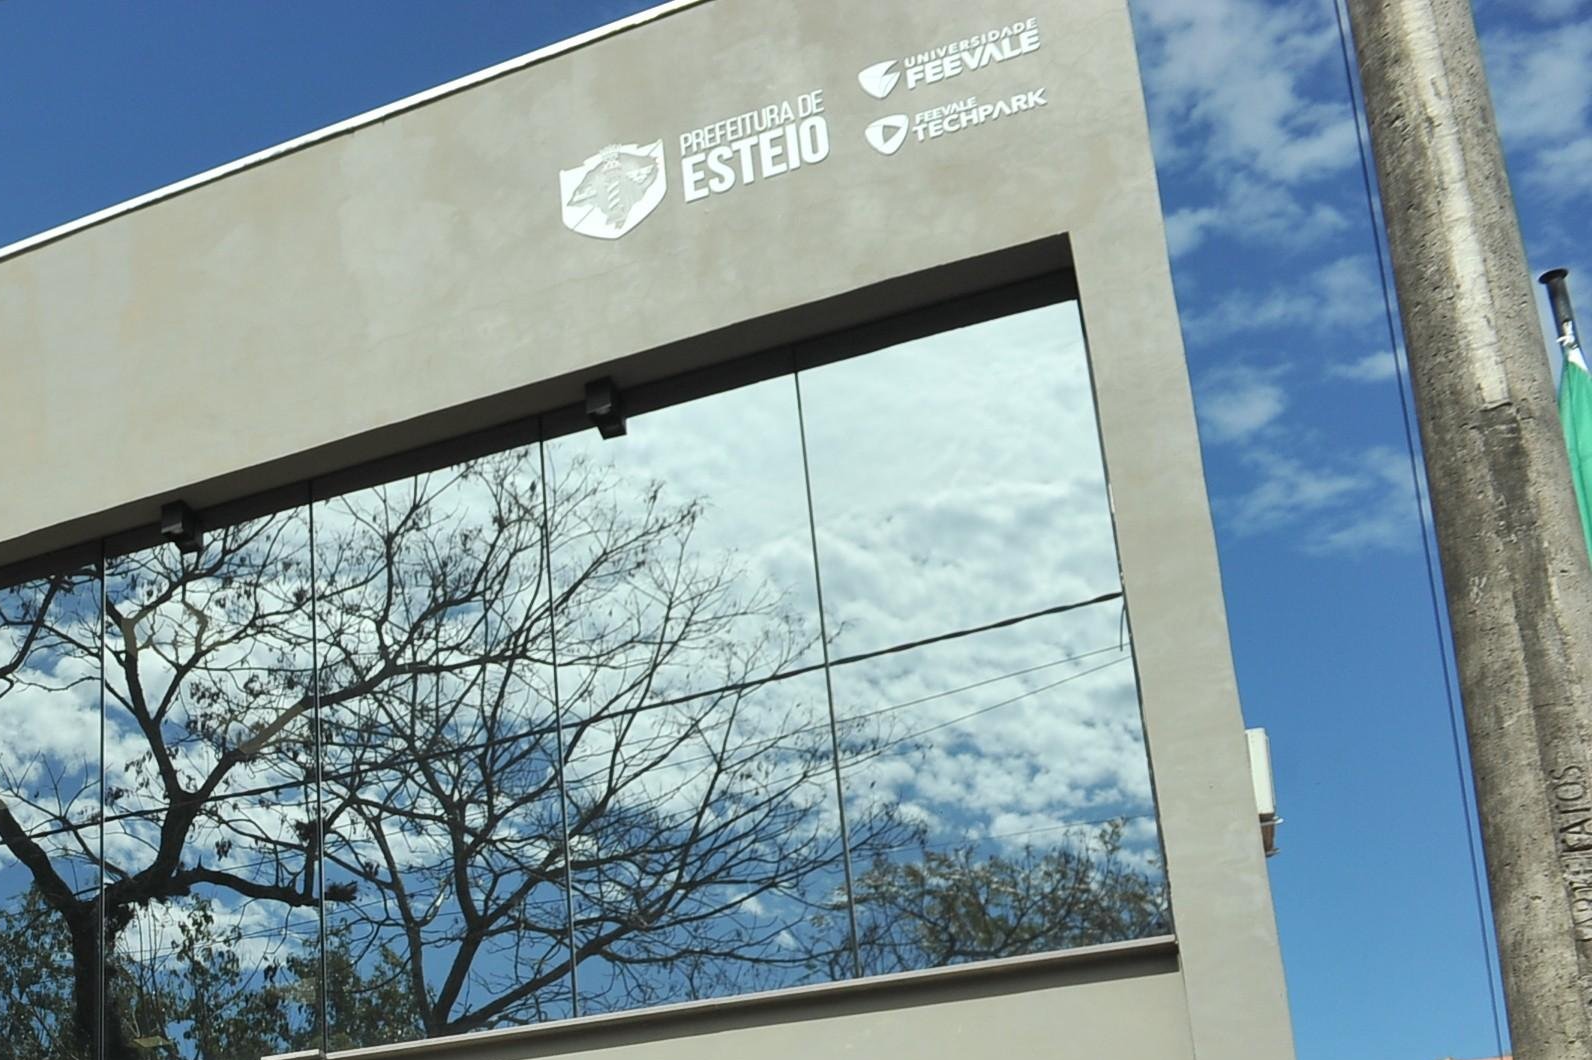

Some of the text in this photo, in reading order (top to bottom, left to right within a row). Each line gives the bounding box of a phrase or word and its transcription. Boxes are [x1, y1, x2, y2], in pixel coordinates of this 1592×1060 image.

[904, 17, 1037, 68] UNIVERSIDADE
[906, 28, 1040, 91] FEEVALE
[679, 88, 825, 157] PREFEITURA DE
[912, 87, 1048, 142] TECHPARK
[915, 96, 978, 125] FEEVALE
[681, 115, 830, 203] ESTEIO
